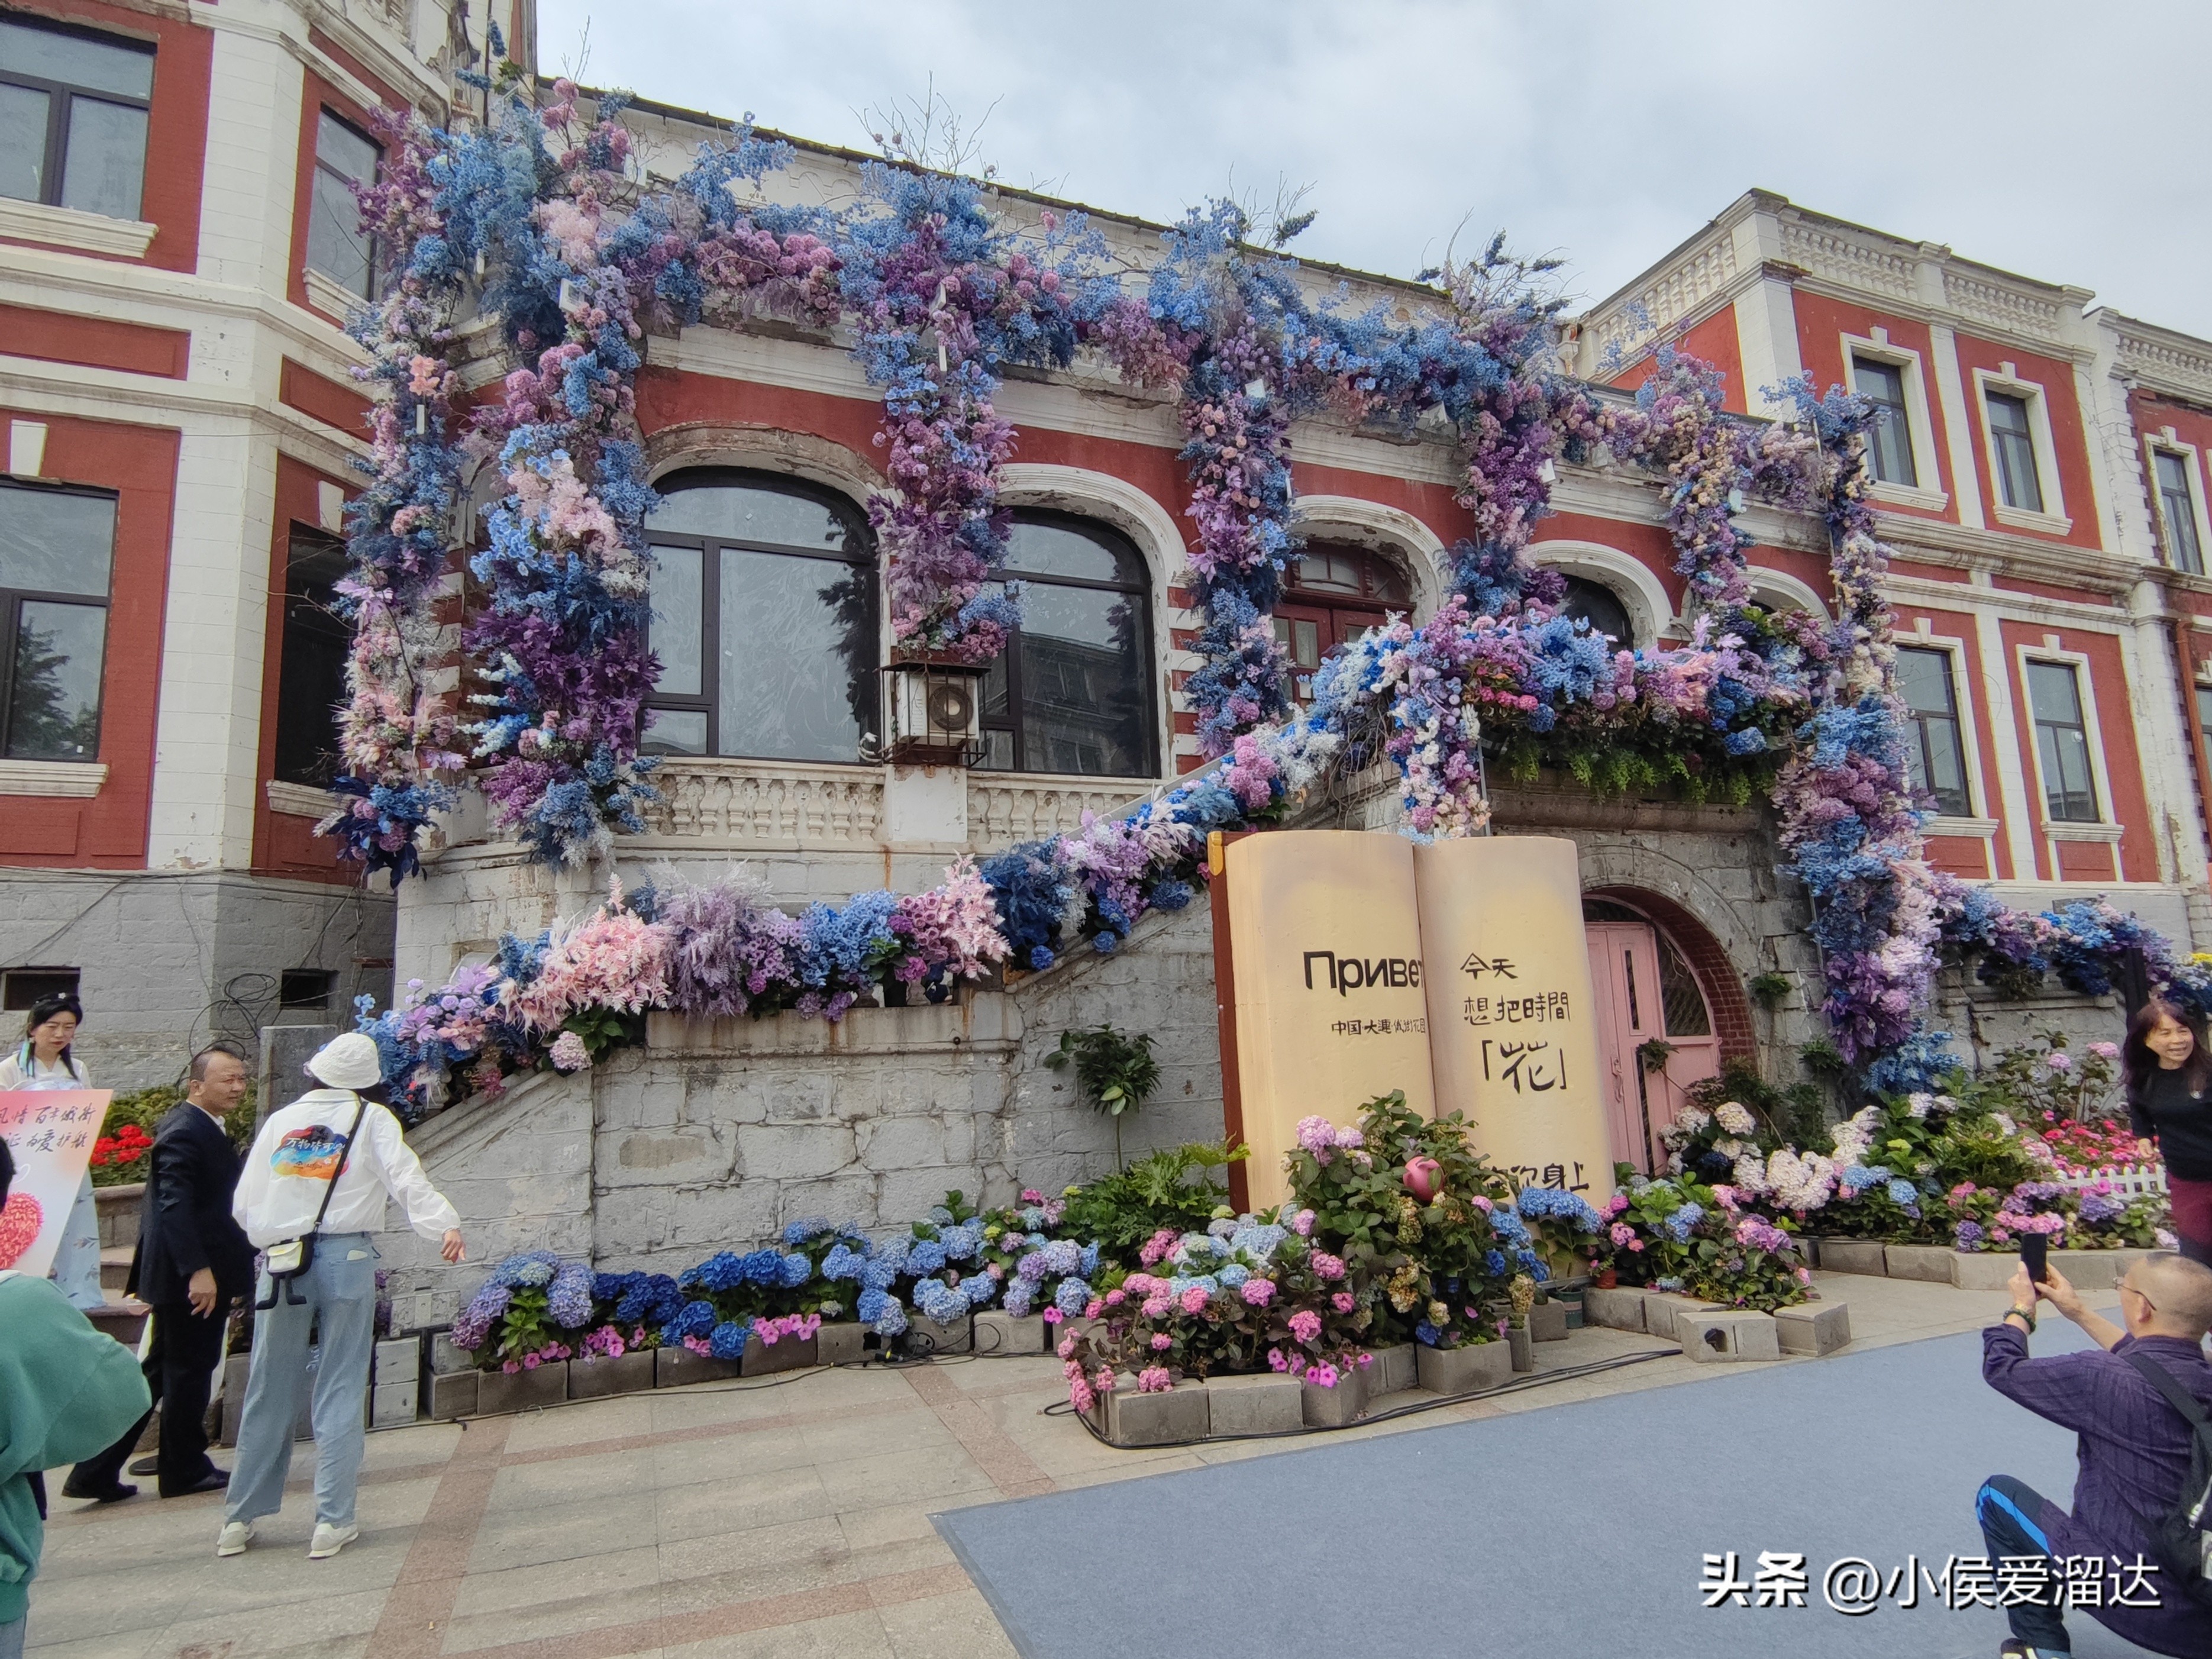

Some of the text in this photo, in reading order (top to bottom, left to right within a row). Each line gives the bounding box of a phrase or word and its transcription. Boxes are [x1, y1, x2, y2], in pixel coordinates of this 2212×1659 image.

[1460, 952, 1518, 980] 今天
[1464, 991, 1571, 1026] 想把時間
